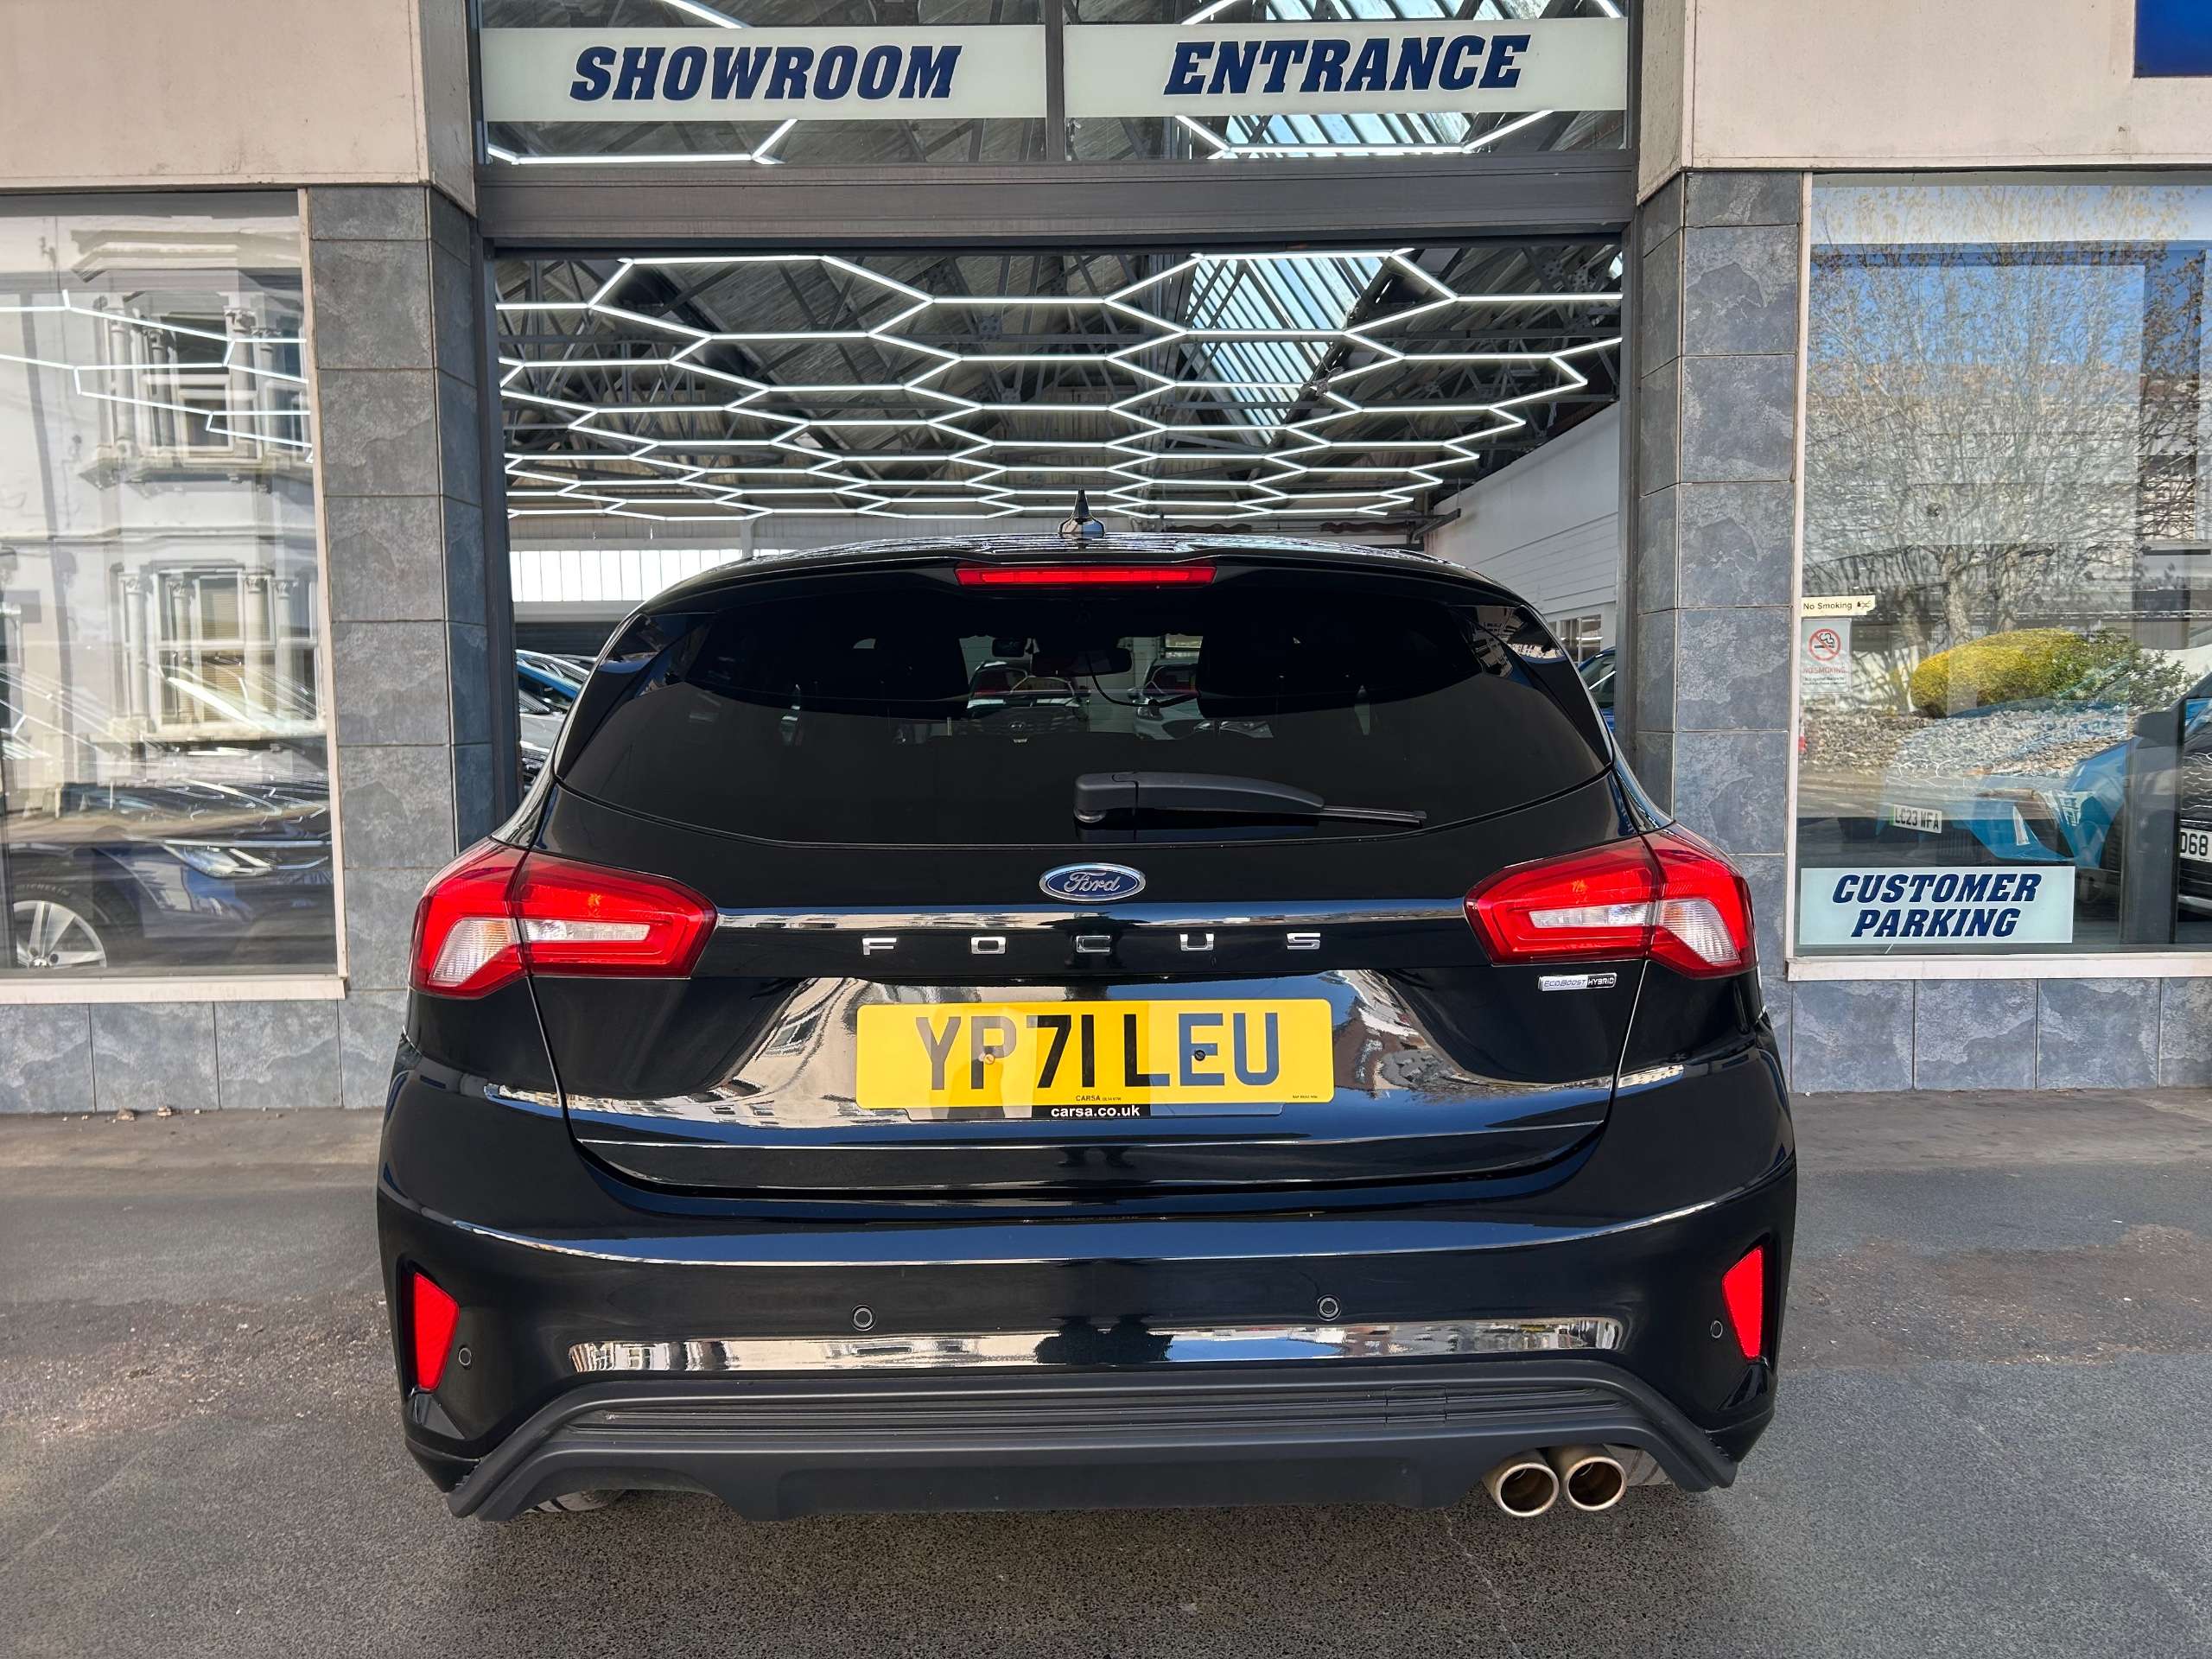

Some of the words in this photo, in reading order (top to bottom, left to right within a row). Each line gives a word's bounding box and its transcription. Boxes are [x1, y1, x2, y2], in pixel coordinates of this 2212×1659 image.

[569, 45, 962, 102] SHOWROOM
[1162, 34, 1530, 95] ENTRANCE
[1817, 601, 1853, 611] Smoking
[1895, 807, 1918, 826] LC23
[1920, 810, 1939, 830] WFA
[2179, 832, 2209, 856] D68
[1064, 872, 1121, 893] Ford
[1832, 874, 2042, 904] CUSTOMER
[1851, 908, 2020, 938] PARKING
[862, 932, 1321, 955] FOCUS
[915, 1014, 1095, 1091] YP71
[1123, 1012, 1281, 1088] LEU
[1051, 1105, 1141, 1117] carsa.co.uk
